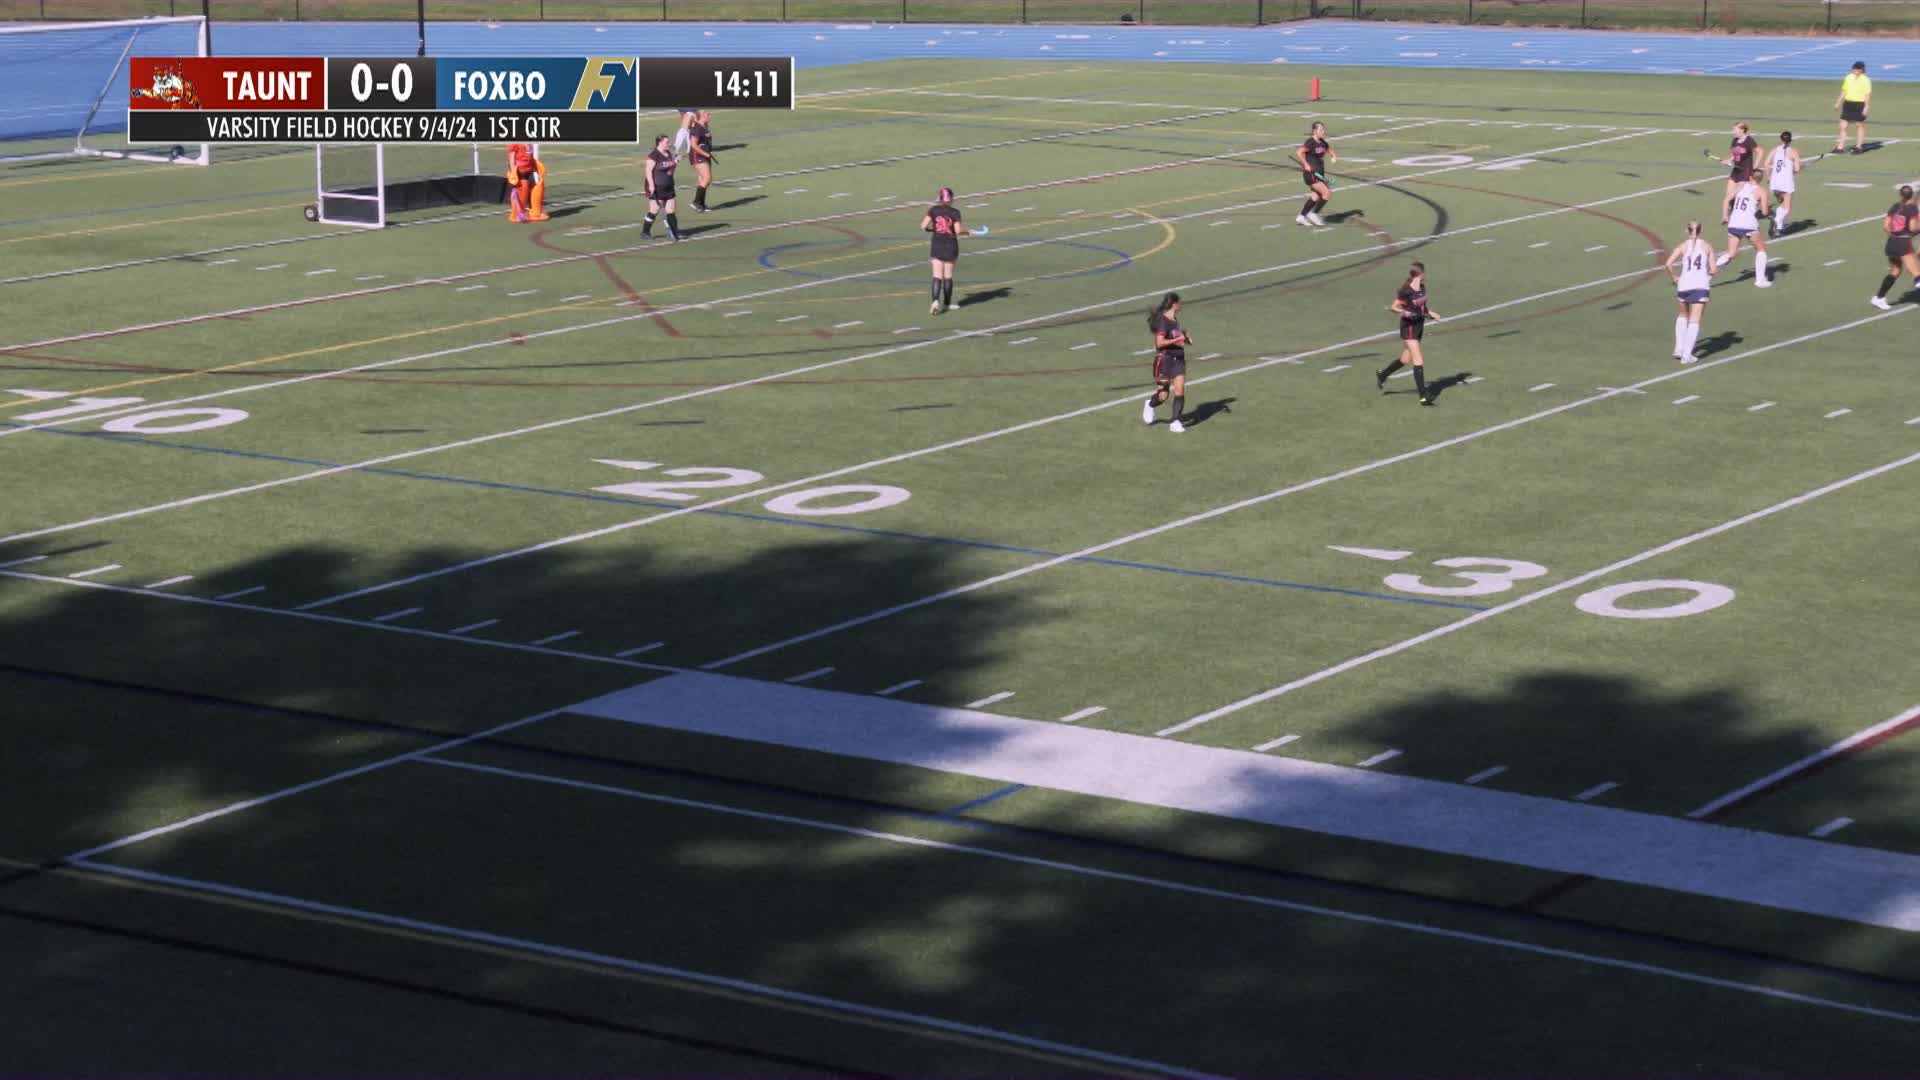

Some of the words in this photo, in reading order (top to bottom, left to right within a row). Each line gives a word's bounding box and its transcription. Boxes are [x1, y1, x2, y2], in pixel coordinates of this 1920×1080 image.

[1734, 197, 1750, 211] 16
[1686, 255, 1702, 271] 14
[588, 466, 912, 516] 20
[1383, 556, 1736, 619] 30
